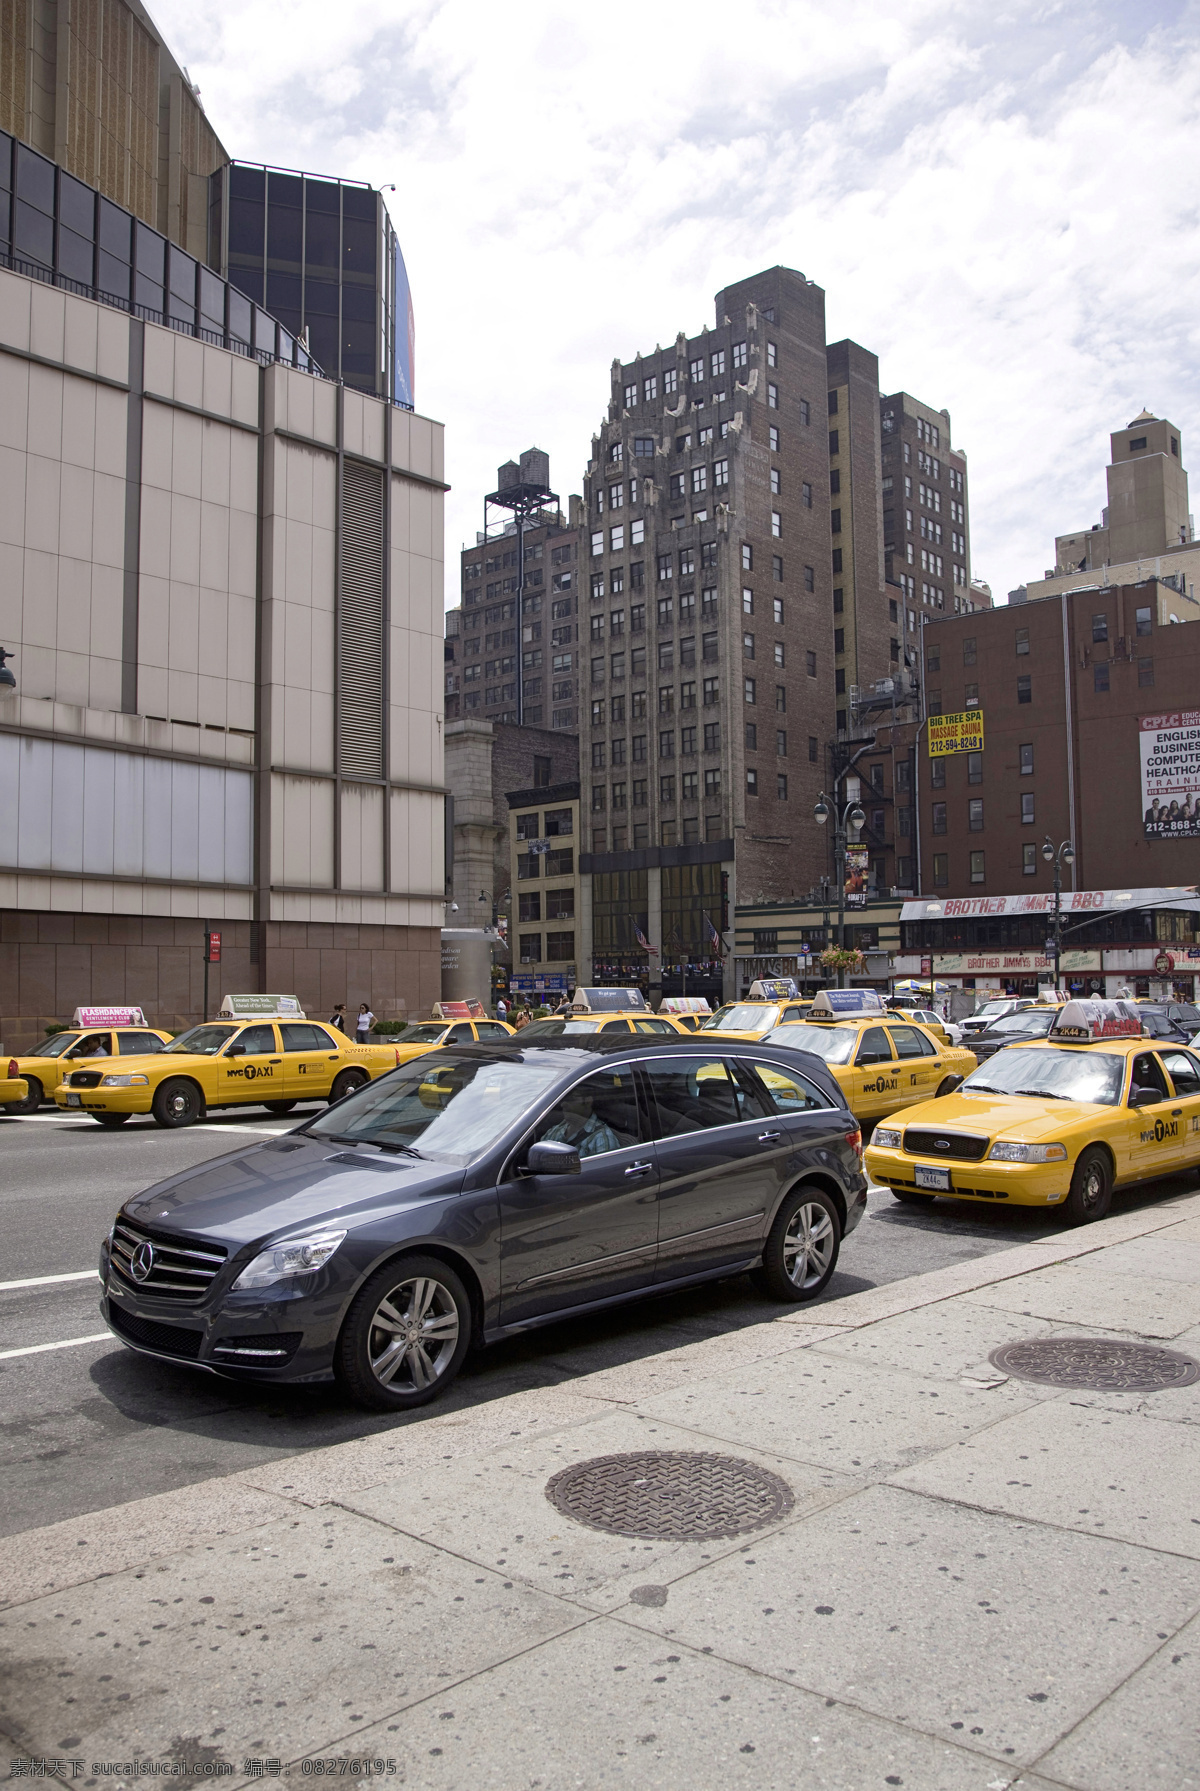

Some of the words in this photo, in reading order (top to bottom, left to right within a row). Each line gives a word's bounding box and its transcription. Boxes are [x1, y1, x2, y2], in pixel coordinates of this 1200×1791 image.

[930, 717, 943, 727] BIG
[945, 714, 964, 725] TREE
[965, 711, 982, 722] SPA
[1142, 714, 1180, 730] CPLC
[930, 725, 959, 740] MASSAGE
[960, 722, 982, 736] SAUNA
[931, 736, 978, 753] 212-594-8248
[944, 897, 1007, 915] BROTHER
[1071, 891, 1105, 909] BBQ
[441, 946, 461, 954] adison
[967, 957, 1000, 969] BROTHER
[82, 1008, 137, 1016] FLASHDANCERS
[1059, 1028, 1079, 1036] 2K44
[1093, 1019, 1141, 1037] CHICAGO
[227, 1070, 244, 1078] NYC
[244, 1065, 273, 1080] TAXI
[863, 1084, 876, 1093] NYC
[876, 1076, 898, 1094] TAXI
[1140, 1130, 1155, 1143] NYC
[1154, 1119, 1178, 1142] TAXI
